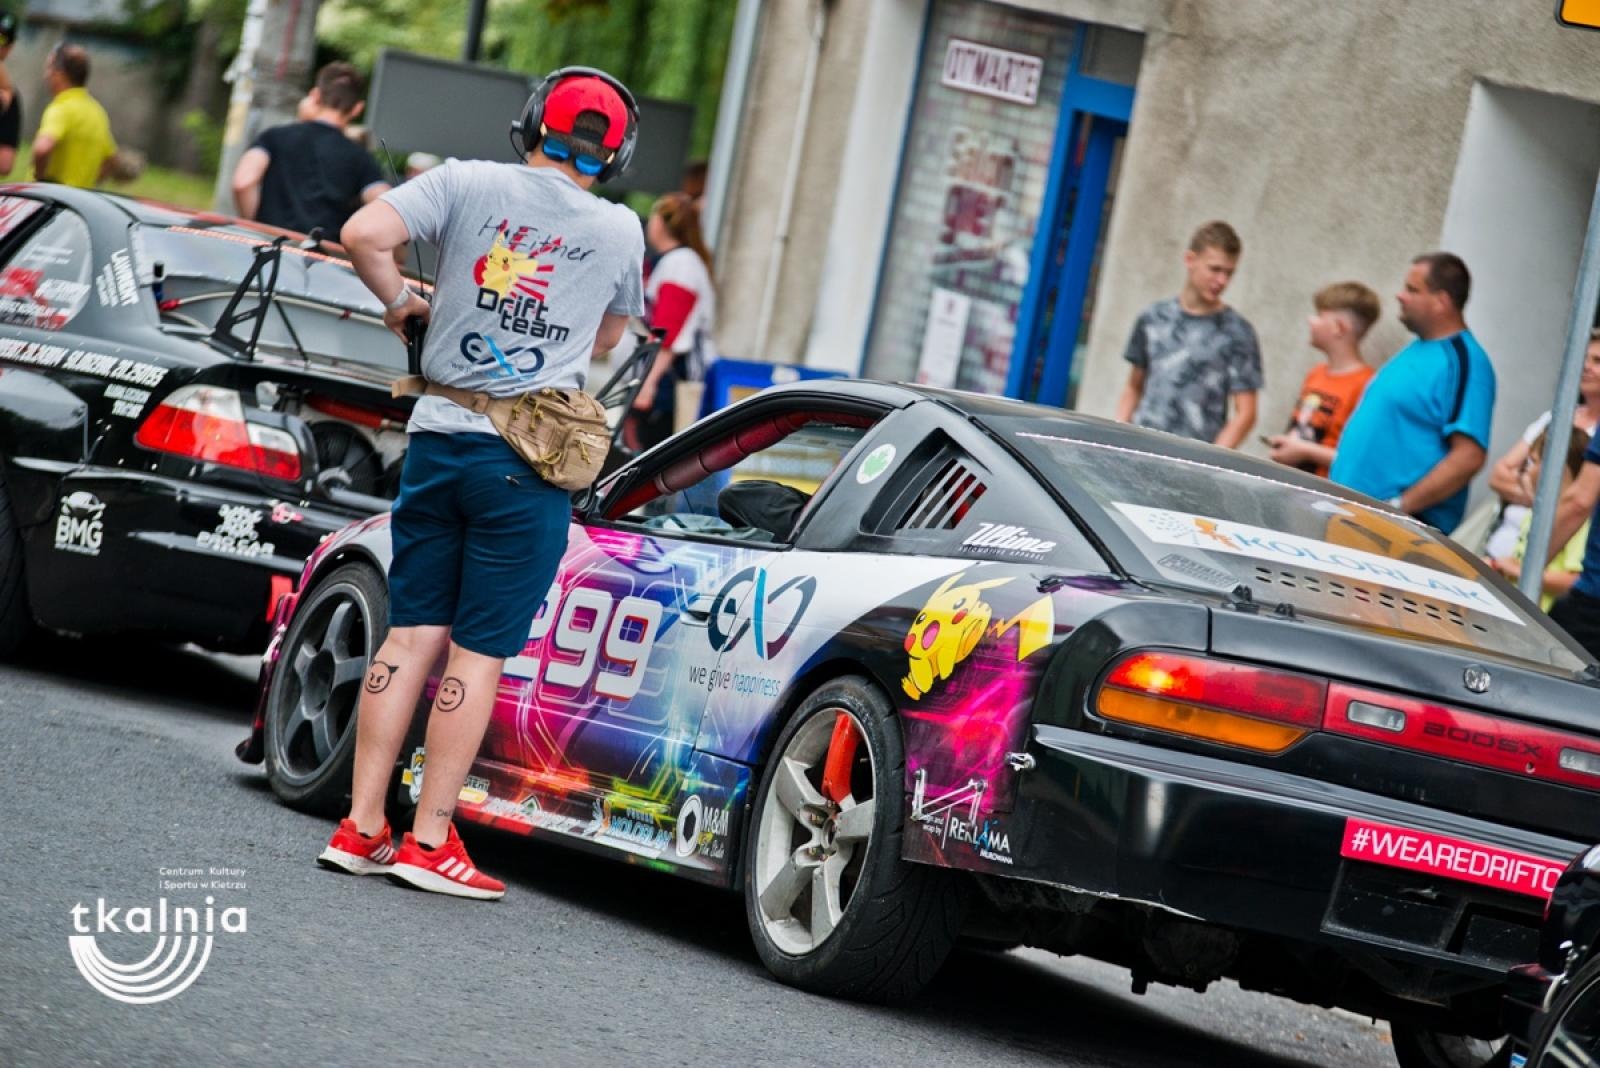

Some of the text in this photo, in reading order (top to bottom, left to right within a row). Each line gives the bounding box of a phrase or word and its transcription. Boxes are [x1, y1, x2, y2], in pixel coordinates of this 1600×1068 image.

[476, 287, 549, 323] Drift
[500, 311, 570, 342] team
[56, 514, 104, 549] BMG
[1233, 531, 1491, 607] KOLORLAK
[689, 664, 781, 697] we give happiness
[1423, 721, 1543, 759] 200SX
[701, 805, 729, 837] M&M
